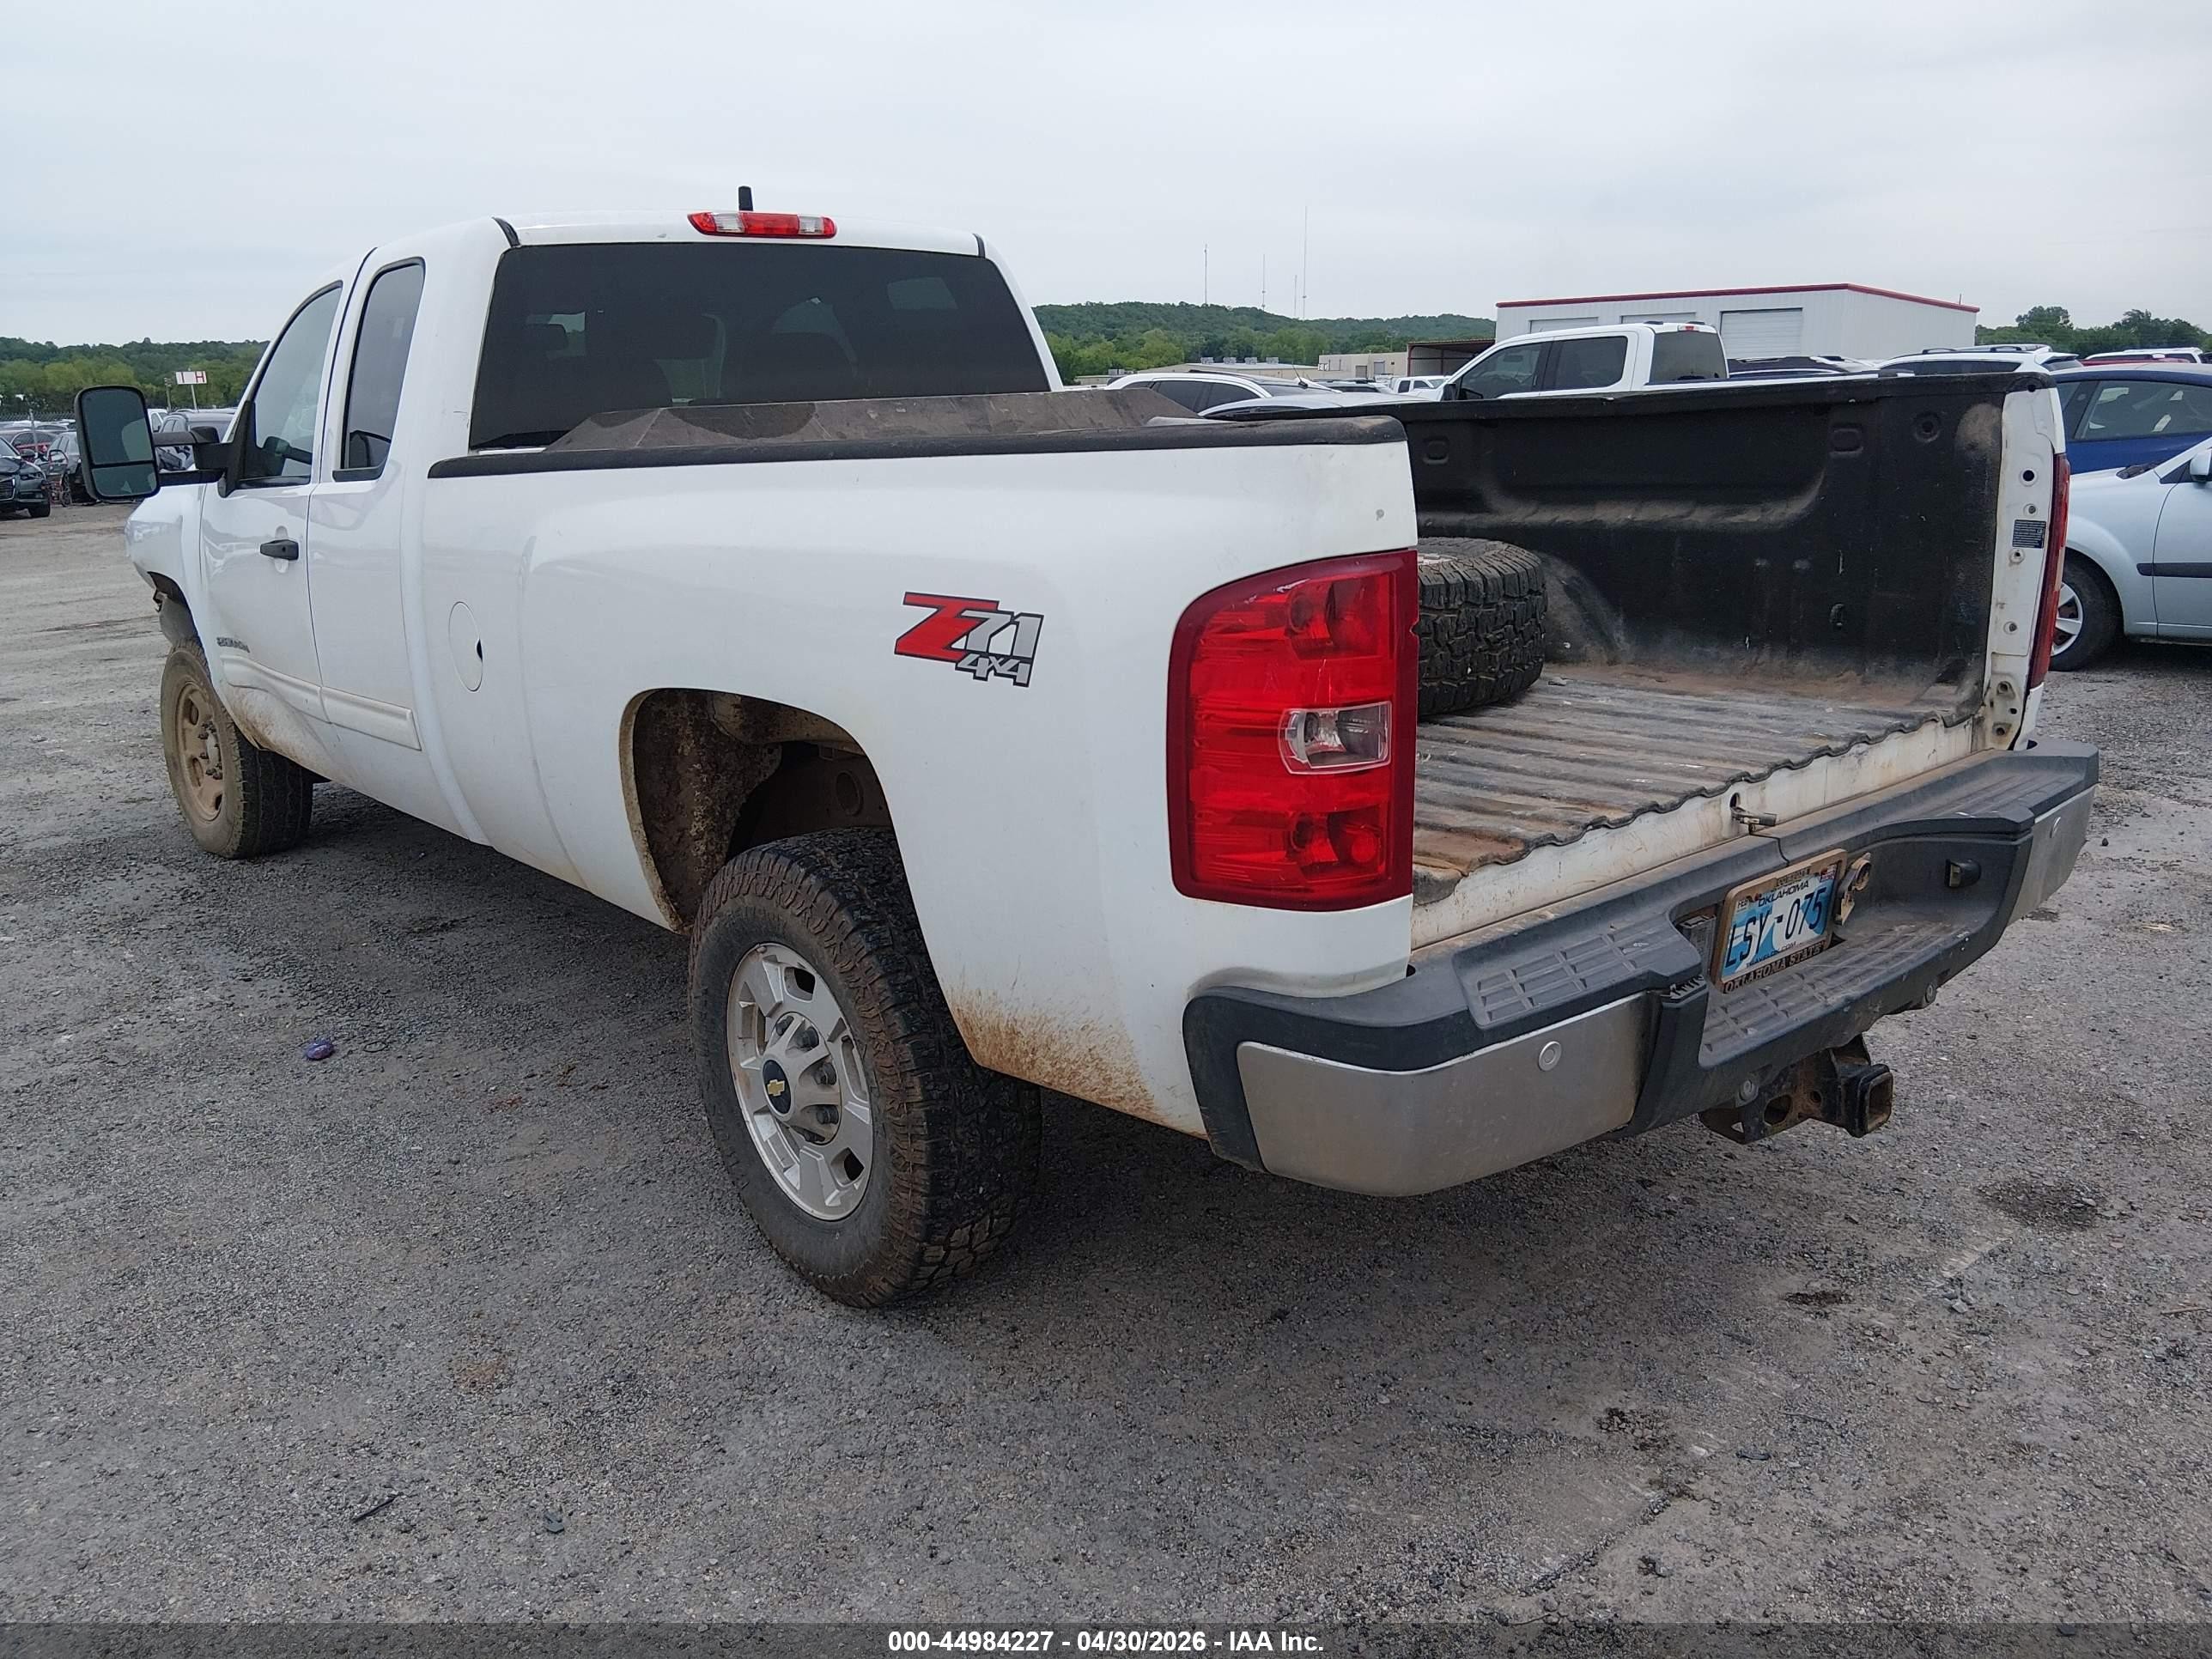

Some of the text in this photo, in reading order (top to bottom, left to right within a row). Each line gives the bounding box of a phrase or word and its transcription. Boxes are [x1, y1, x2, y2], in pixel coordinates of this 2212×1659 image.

[894, 592, 1045, 665] Z71
[1758, 880, 1809, 907] OKLAHOMA
[1723, 944, 1823, 994] OKLAHOMA STATE
